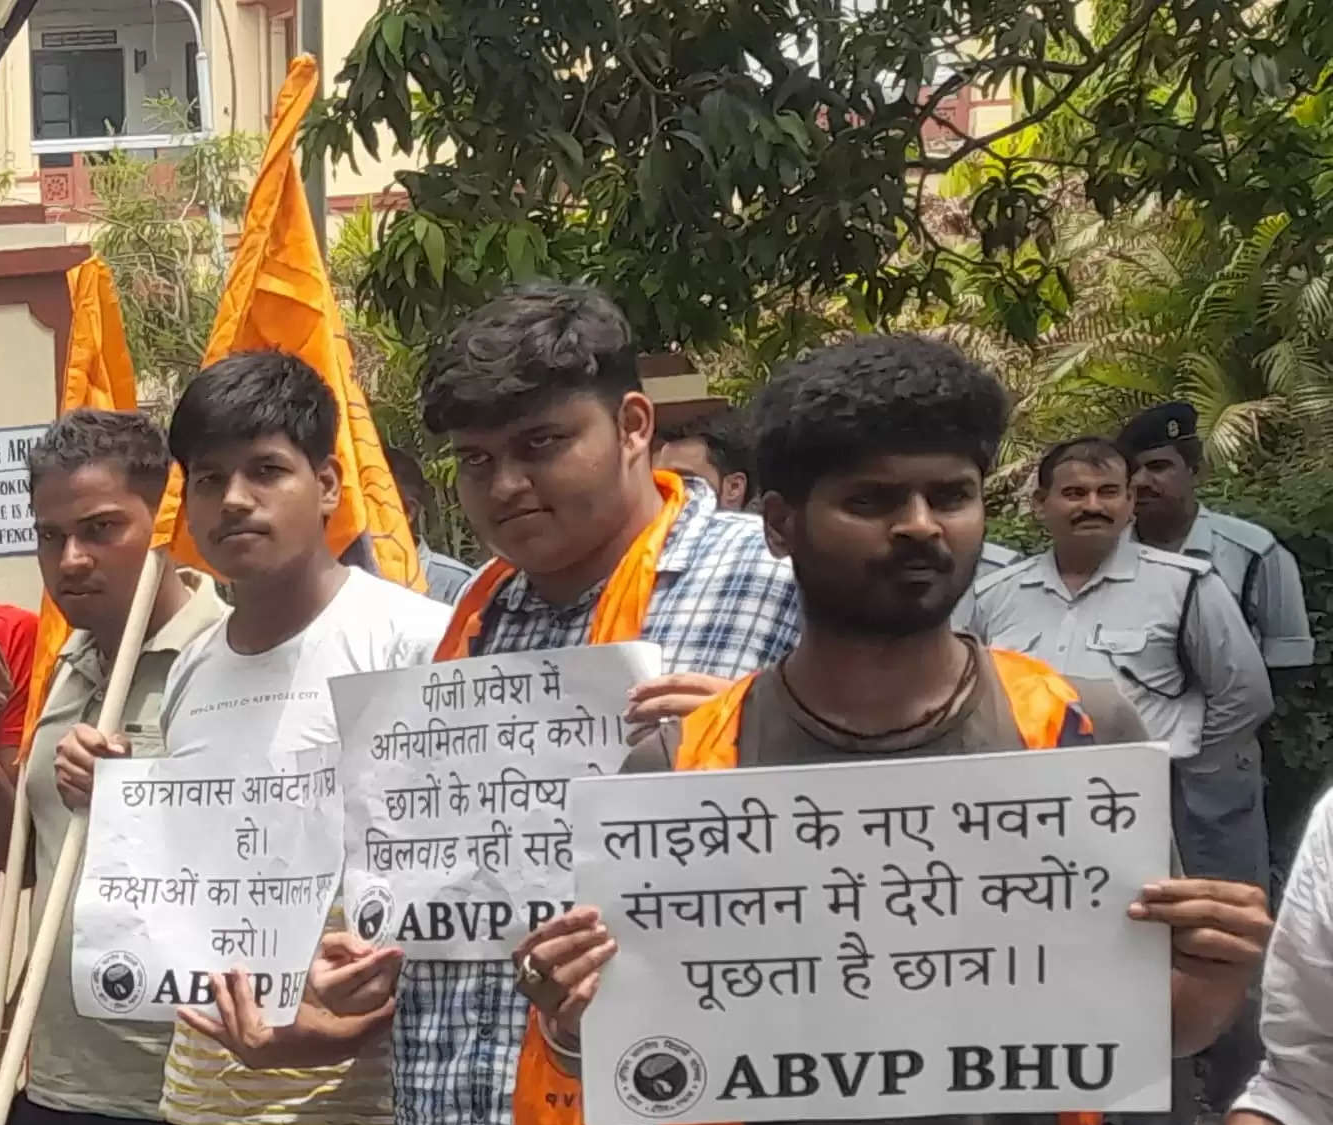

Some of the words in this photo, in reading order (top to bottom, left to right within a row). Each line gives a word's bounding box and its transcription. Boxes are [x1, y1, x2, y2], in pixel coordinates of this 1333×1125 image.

[12, 504, 22, 519] IS
[421, 669, 465, 713] पीजी
[473, 664, 532, 708] प्रवेश
[540, 661, 561, 701] में
[371, 717, 489, 761] अनियमितता
[497, 715, 539, 755] बंद
[122, 779, 236, 807] छात्रावास
[241, 768, 310, 805] आवंटन
[384, 774, 441, 821] छात्रों
[449, 771, 471, 816] के
[478, 768, 571, 814] भविष्य
[365, 828, 459, 875] खिलवाड़
[466, 819, 513, 872] नहीं
[522, 818, 573, 872] सहें
[601, 798, 778, 866] लाइब्रेरी
[793, 795, 844, 850] के
[858, 805, 935, 851] नए
[952, 797, 1072, 838] भवन
[1086, 777, 1140, 833] के
[99, 868, 200, 909] कक्षाओं
[207, 879, 241, 906] का
[247, 872, 313, 906] संचालन
[621, 883, 808, 930] संचालन
[822, 868, 868, 921] में
[881, 861, 963, 926] देरी
[978, 855, 1111, 912] क्यों?
[396, 901, 513, 941] ABVP
[152, 968, 273, 1008] ABP
[280, 970, 306, 1008] BH
[682, 956, 821, 1011] पूछता
[837, 932, 874, 999] है
[716, 1049, 925, 1100] ABVP
[947, 1043, 1120, 1092] BHU
